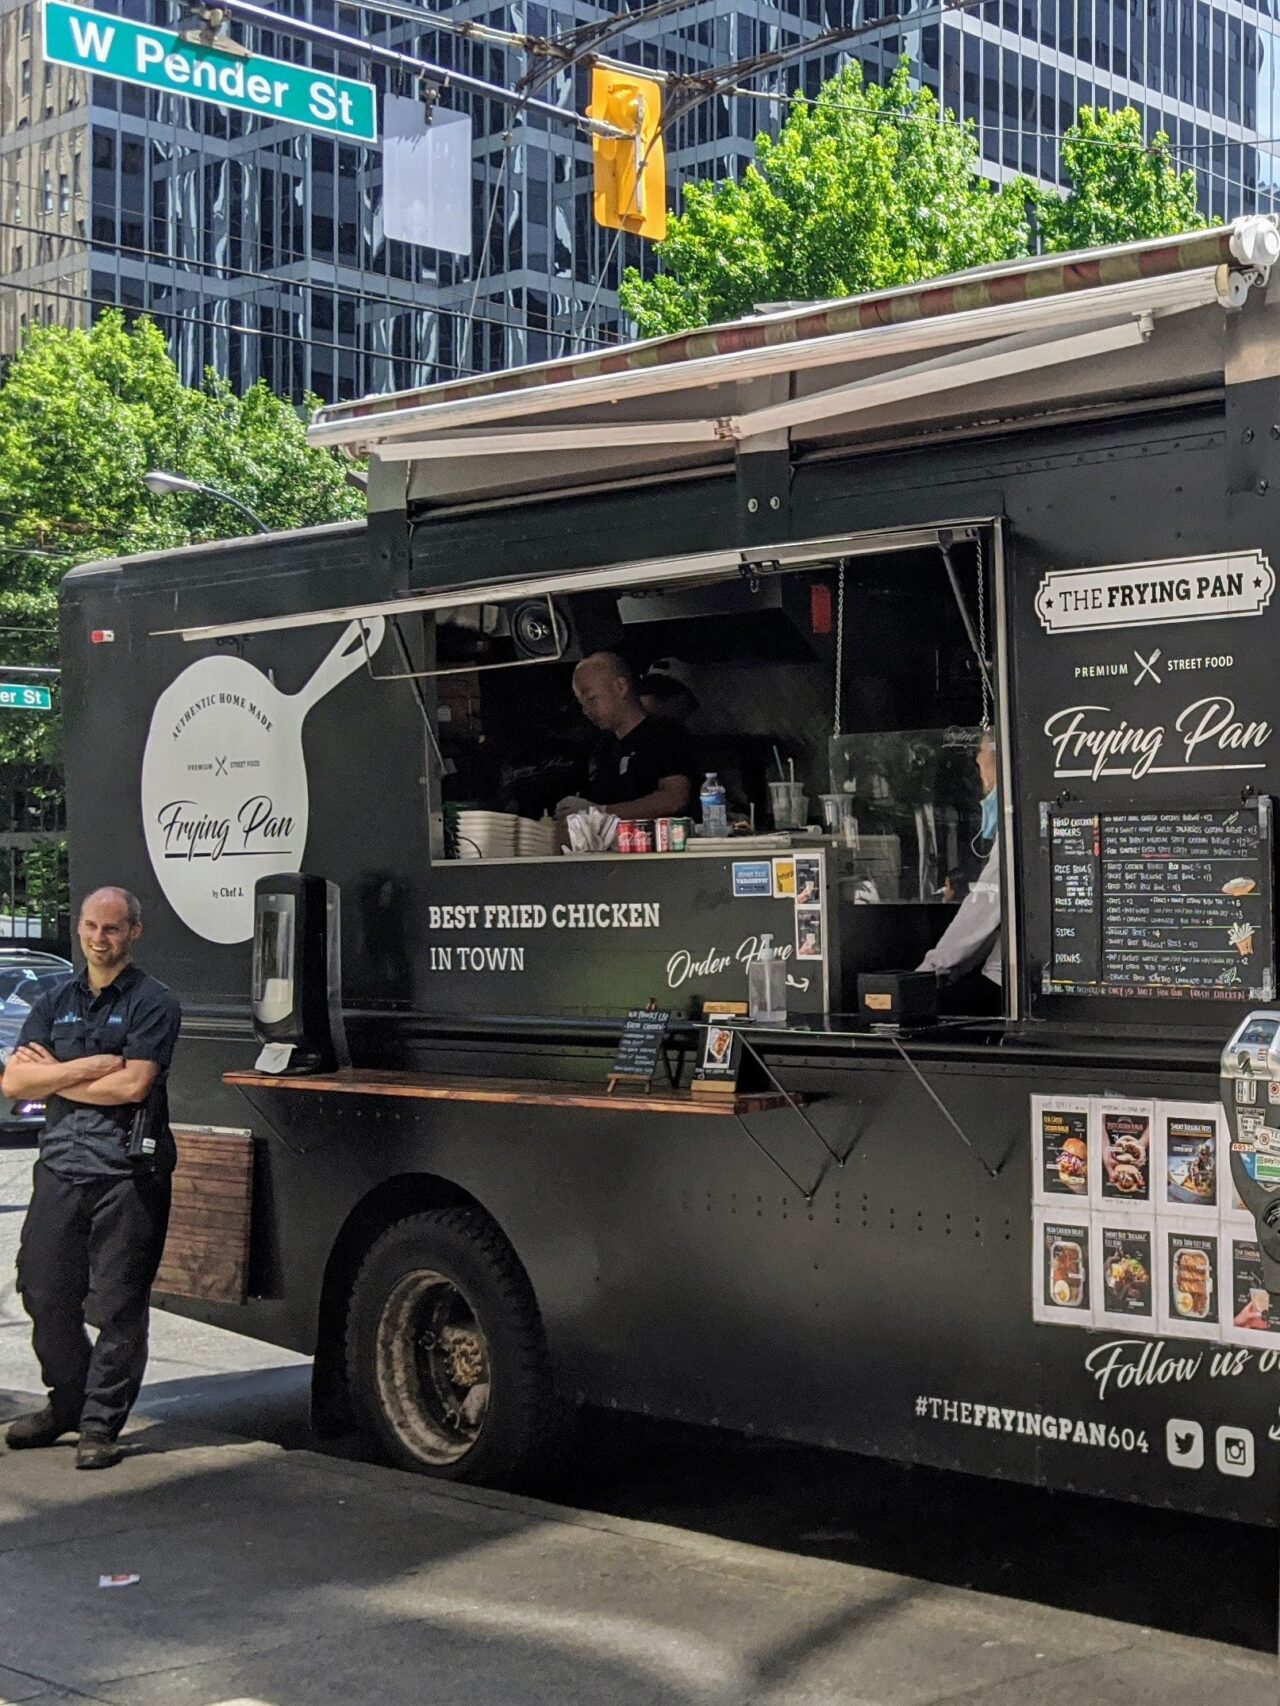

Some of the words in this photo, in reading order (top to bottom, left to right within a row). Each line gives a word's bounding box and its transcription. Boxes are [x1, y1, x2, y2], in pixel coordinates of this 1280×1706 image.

[68, 16, 115, 60] W
[135, 35, 289, 108] Pender
[308, 80, 355, 127] St
[1059, 588, 1102, 612] THE
[1108, 578, 1191, 608] FRYING
[1196, 573, 1244, 599] PAN
[1074, 663, 1129, 678] PREMIUM
[1167, 657, 1202, 671] STREET
[1205, 655, 1234, 669] FOOD
[23, 689, 42, 704] St
[172, 693, 217, 741] AUTHENTIC
[219, 692, 247, 709] HOME
[248, 704, 274, 734] MADE
[1044, 705, 1165, 782] Frying
[1175, 696, 1272, 763] Pan
[157, 800, 230, 862] Frying
[237, 795, 295, 849] Pan
[1054, 865, 1071, 873] RICE
[1073, 864, 1092, 874] BOWLS
[212, 889, 219, 899] by
[220, 887, 235, 897] Chef
[429, 905, 479, 929] BEST
[484, 904, 547, 928] FRIED
[552, 902, 660, 928] CHICKEN
[1056, 928, 1076, 937] SIDES
[430, 947, 452, 971] IN
[457, 946, 525, 971] TOWN
[667, 949, 732, 988] Order
[1055, 953, 1081, 964] DRINKS
[1085, 1340, 1203, 1399] Follow
[1210, 1348, 1253, 1377] us
[915, 1395, 1150, 1454] #THEFRYINGPAN604
